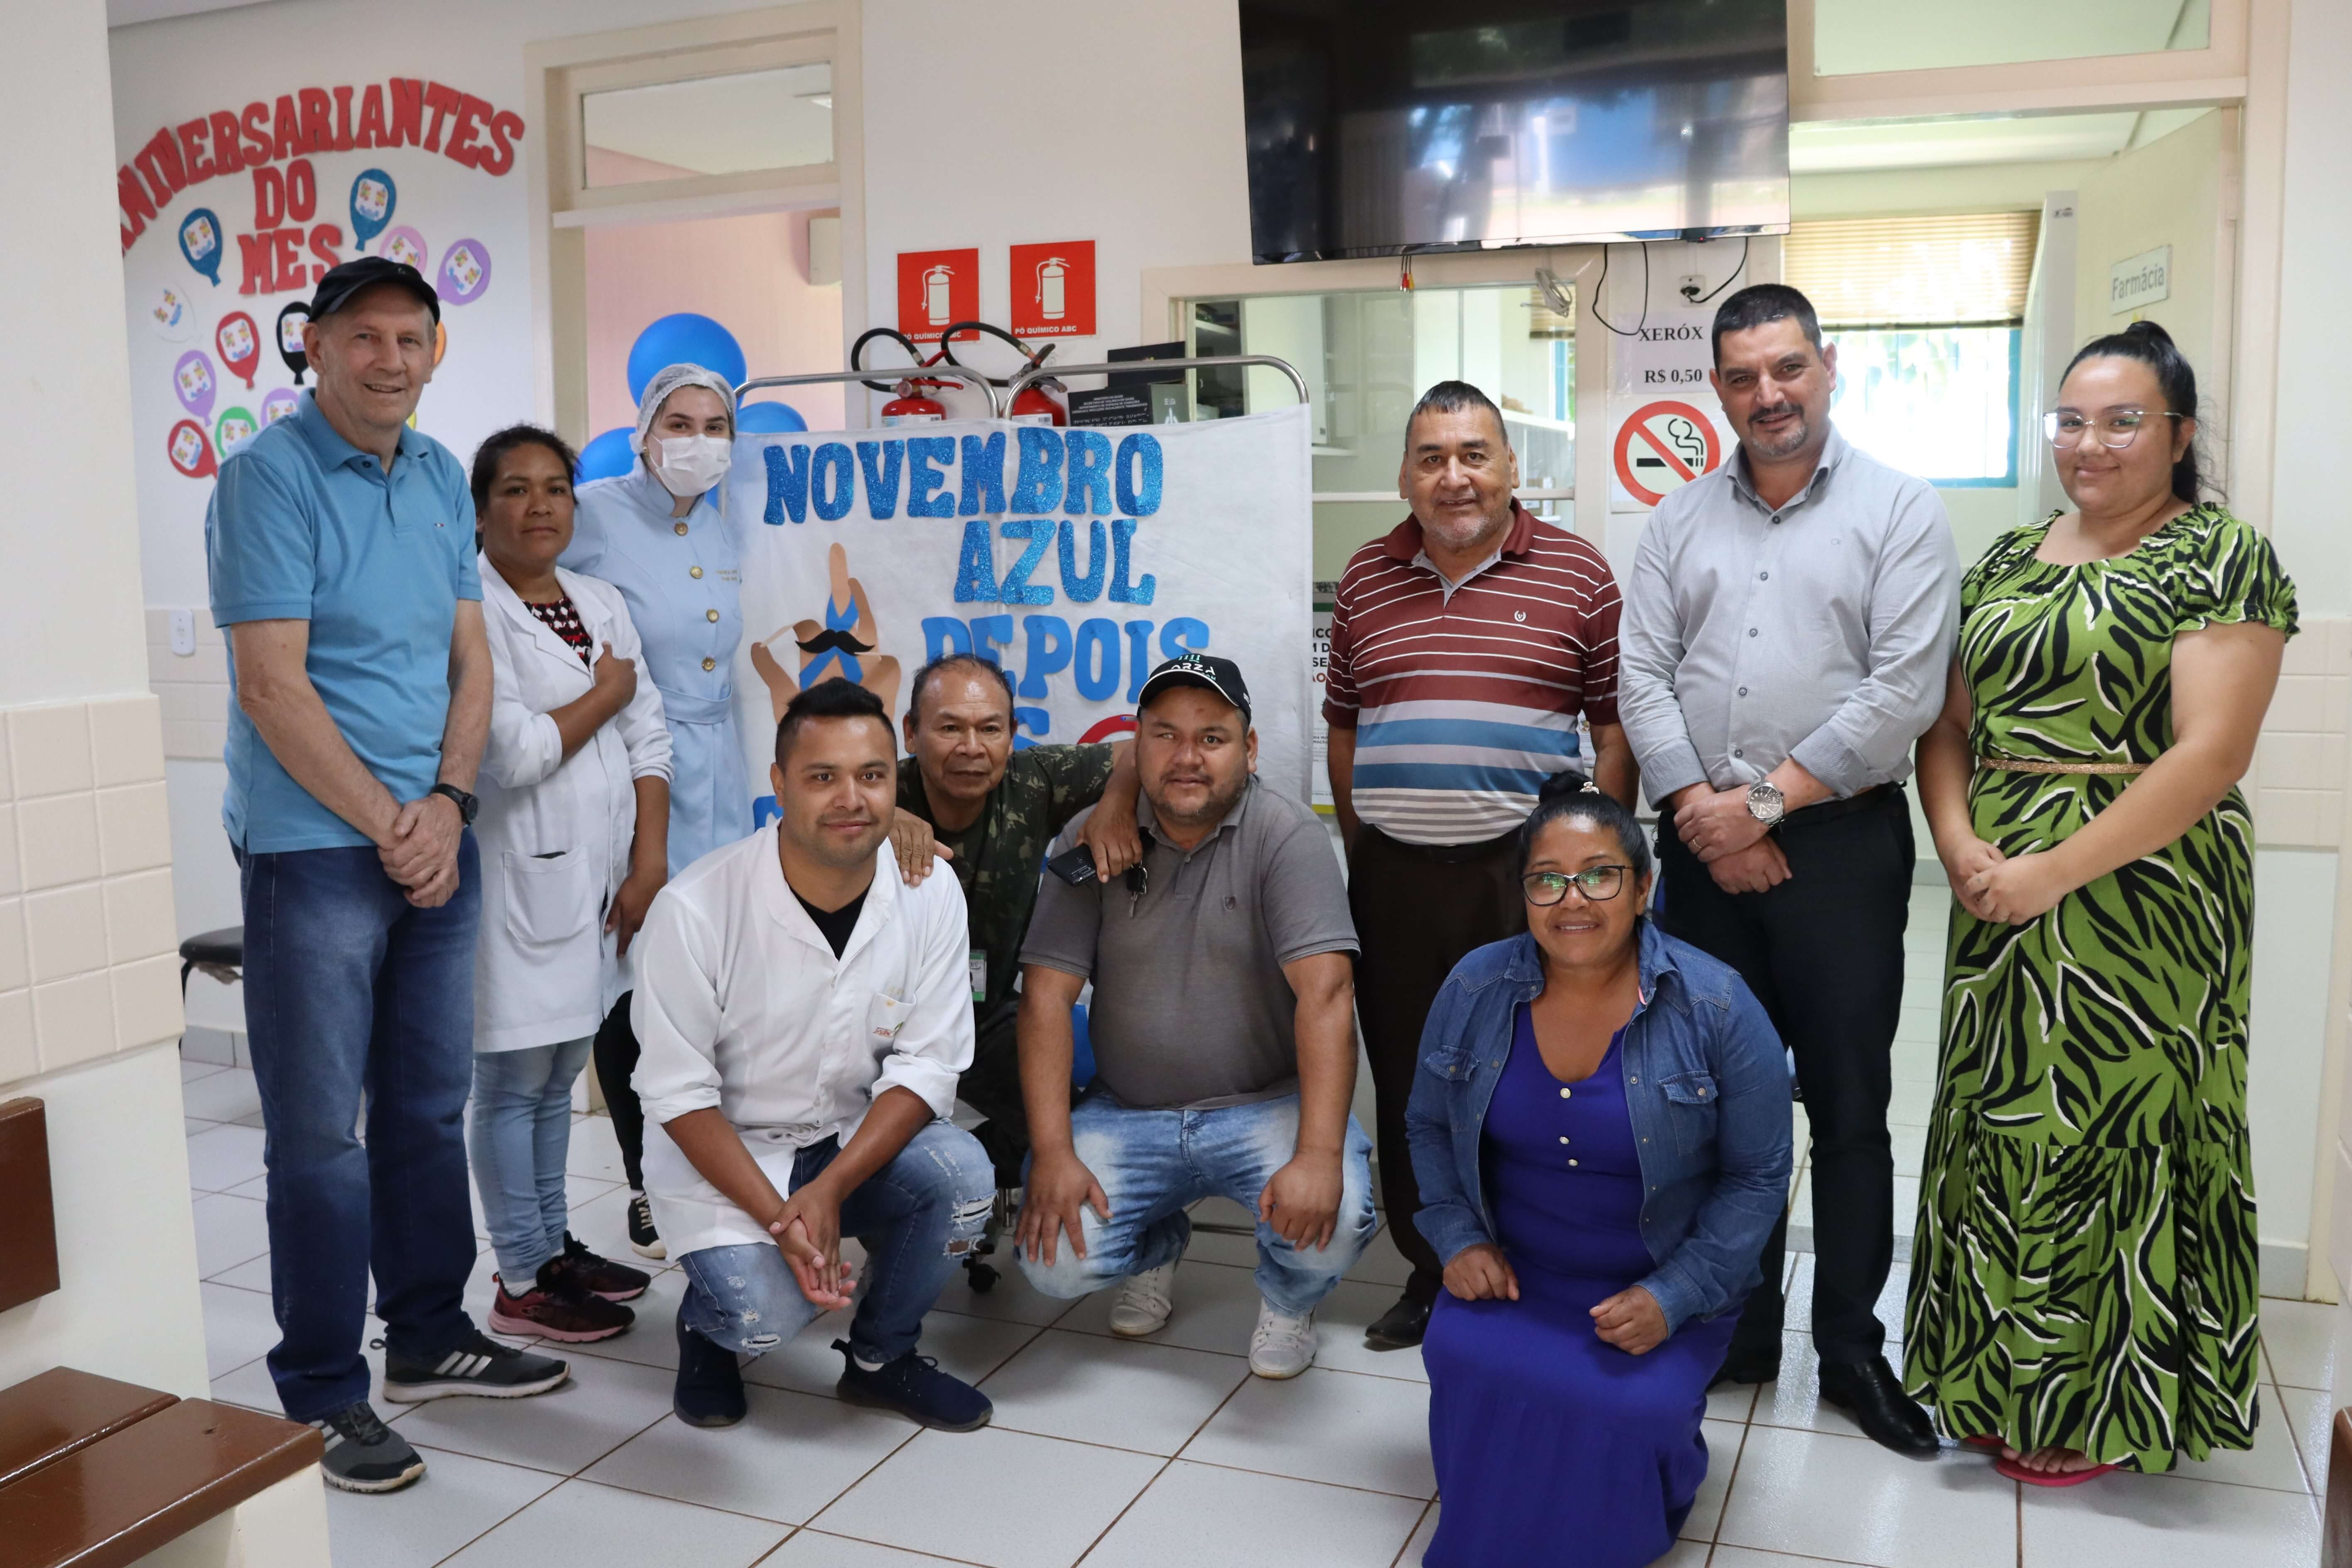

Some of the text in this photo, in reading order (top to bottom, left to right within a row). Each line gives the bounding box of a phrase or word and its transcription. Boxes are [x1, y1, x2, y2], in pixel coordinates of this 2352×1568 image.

[118, 78, 524, 258] NIVERSARIANTES
[253, 159, 316, 230] DO
[238, 224, 342, 294] MES
[2112, 263, 2164, 301] Farmácia
[1027, 326, 1059, 334] QUÍMICO
[1639, 323, 1705, 342] XERÓX
[1644, 369, 1703, 386] R$ 0,50
[763, 427, 1163, 526] NOVEMBRO
[954, 519, 1155, 605] AZUL
